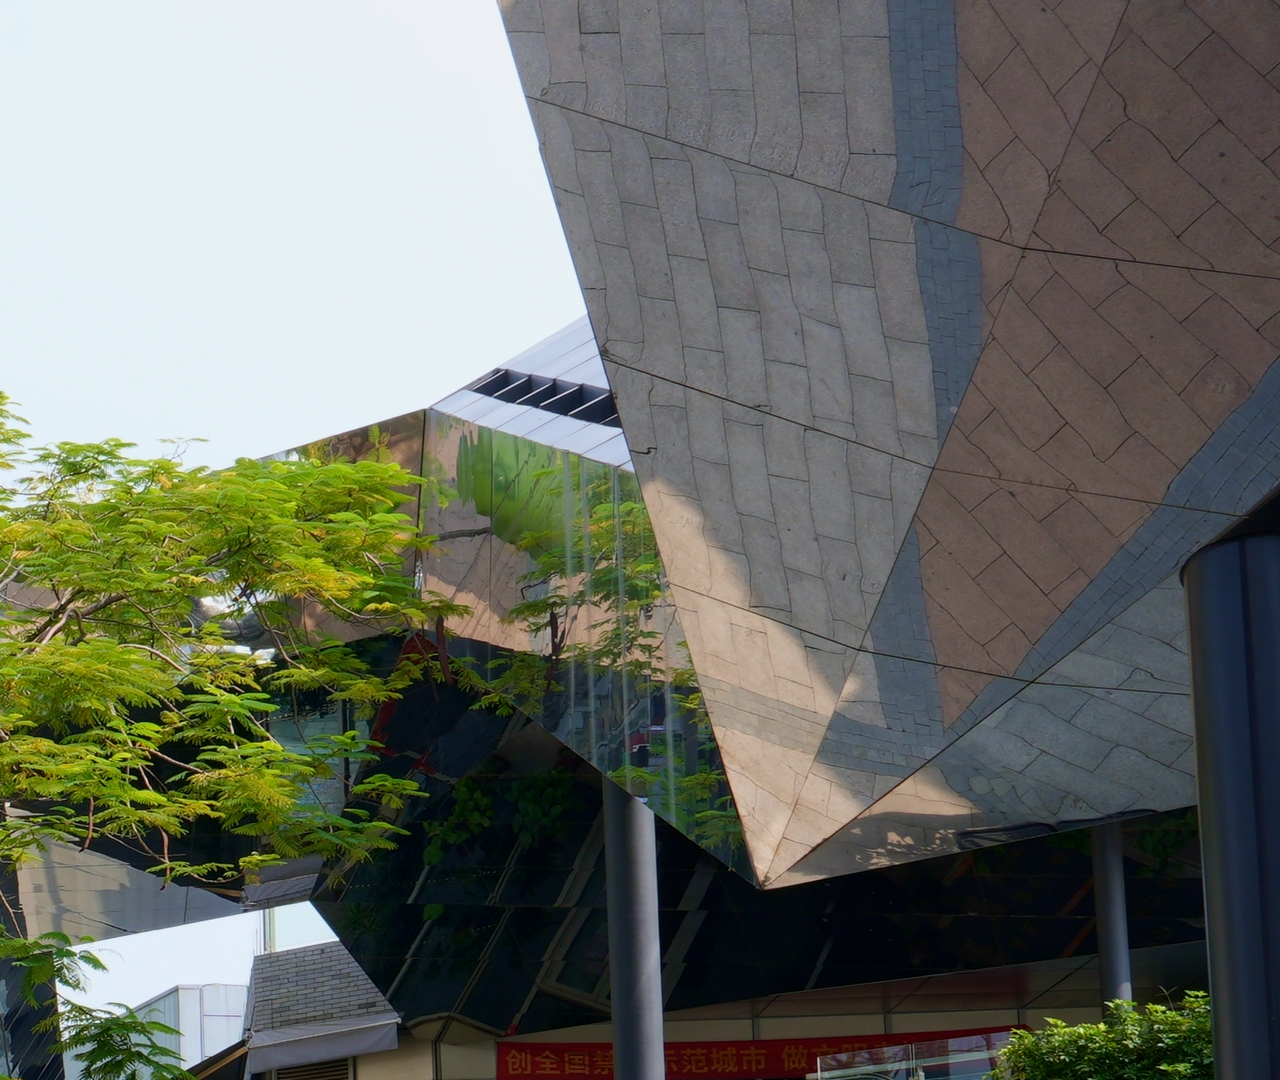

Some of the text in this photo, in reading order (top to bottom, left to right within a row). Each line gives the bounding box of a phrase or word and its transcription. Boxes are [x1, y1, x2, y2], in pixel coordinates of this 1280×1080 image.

[505, 1045, 767, 1075] 创全国禁示范城市
